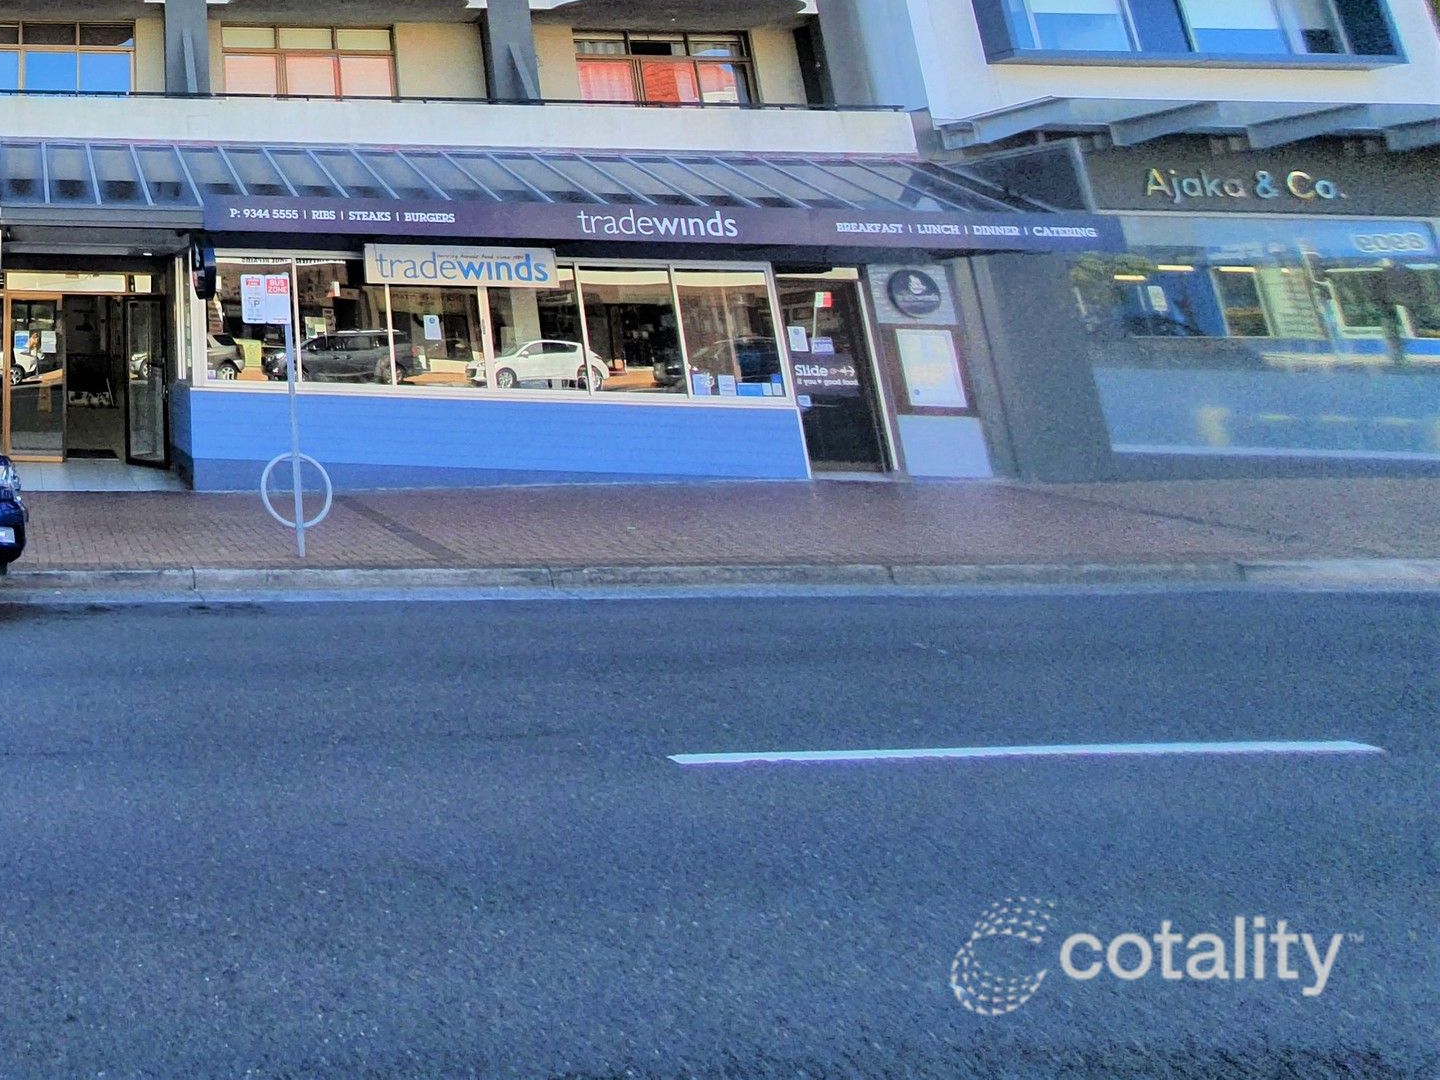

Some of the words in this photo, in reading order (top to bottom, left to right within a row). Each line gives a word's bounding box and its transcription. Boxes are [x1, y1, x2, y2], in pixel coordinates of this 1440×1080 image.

[1146, 169, 1247, 204] Ajaka
[1255, 170, 1279, 199] &
[229, 208, 241, 218] P:
[243, 208, 269, 219] 9344
[272, 209, 299, 219] 5555
[311, 210, 336, 220] RIBS
[348, 211, 391, 221] STEAKS
[404, 212, 455, 223] BURGERS
[577, 208, 738, 237] tradewinds
[836, 222, 903, 234] BREAKFAST
[917, 223, 960, 235] LUNCH
[972, 224, 1020, 236] DINNER
[1032, 226, 1098, 238] CATERING
[375, 251, 549, 282] tradewinds
[794, 364, 829, 377] Slide
